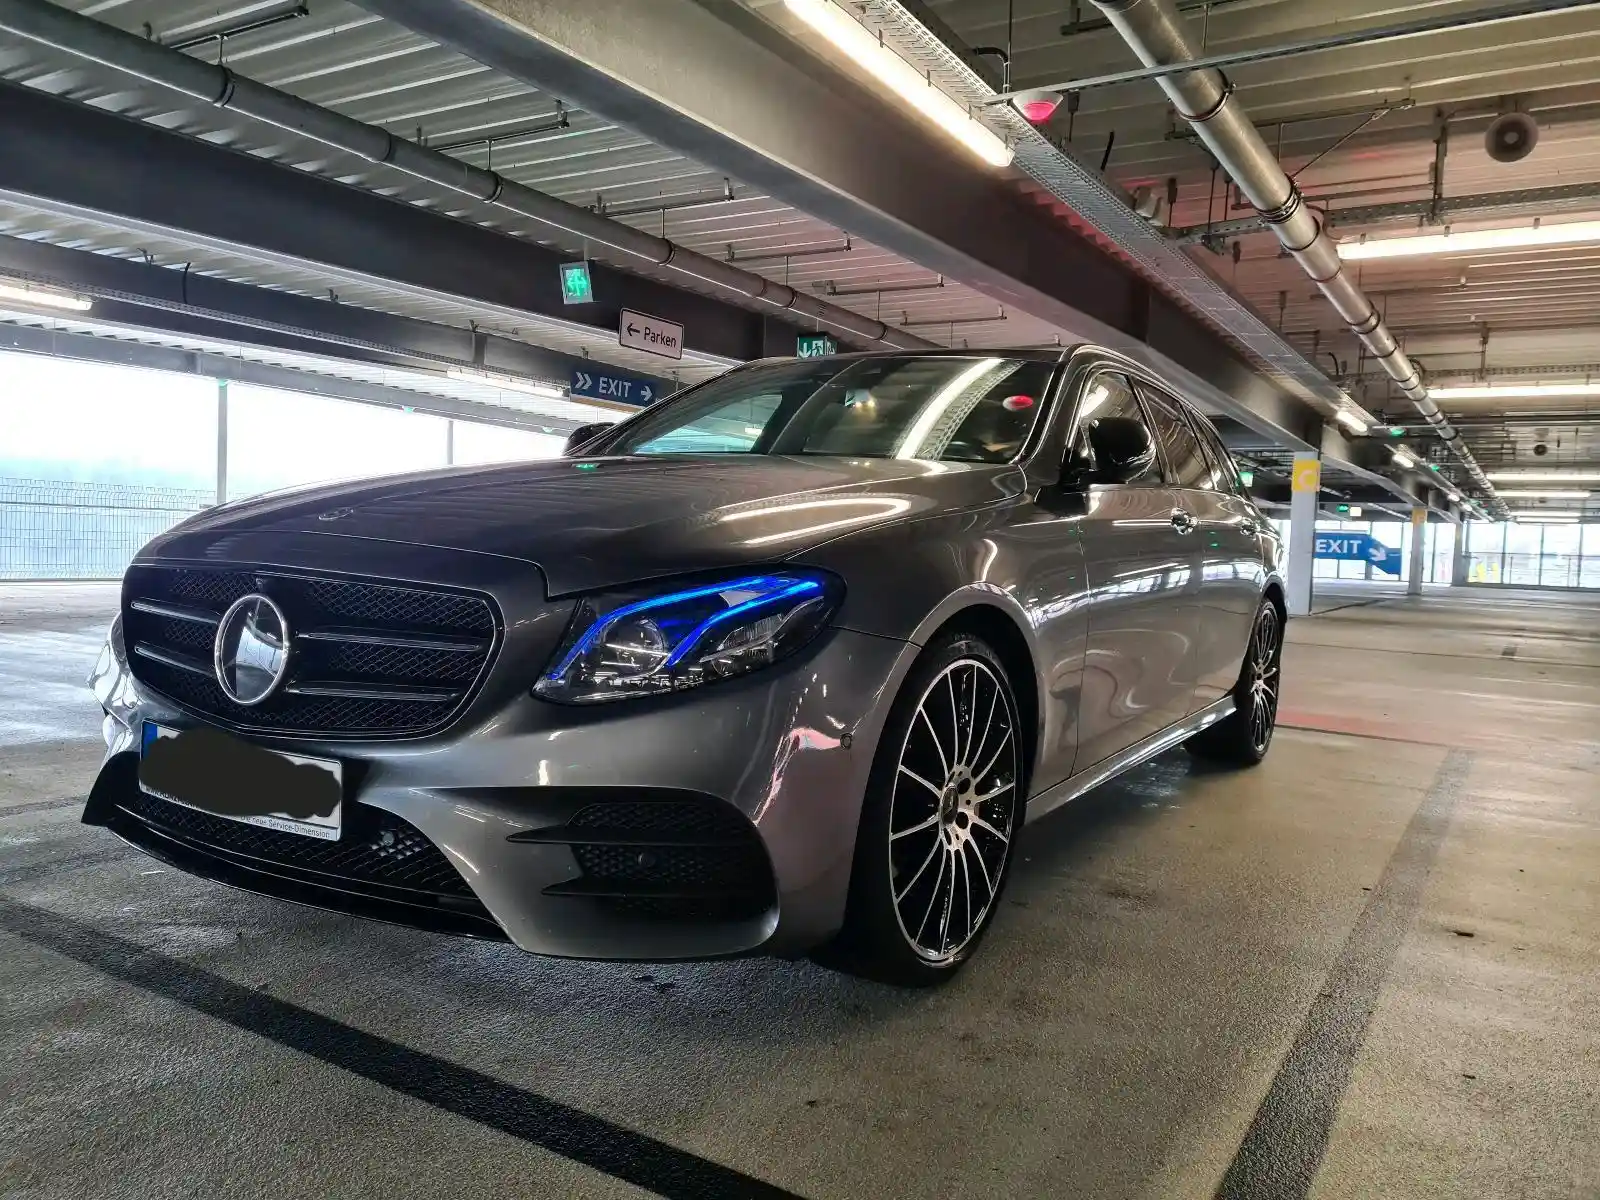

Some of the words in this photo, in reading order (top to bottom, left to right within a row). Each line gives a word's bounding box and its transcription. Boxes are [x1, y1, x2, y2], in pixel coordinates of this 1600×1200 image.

[644, 326, 677, 348] Parken
[598, 377, 632, 398] EXIT
[1315, 539, 1362, 553] EXIT
[268, 819, 330, 839] Service-Dimension
